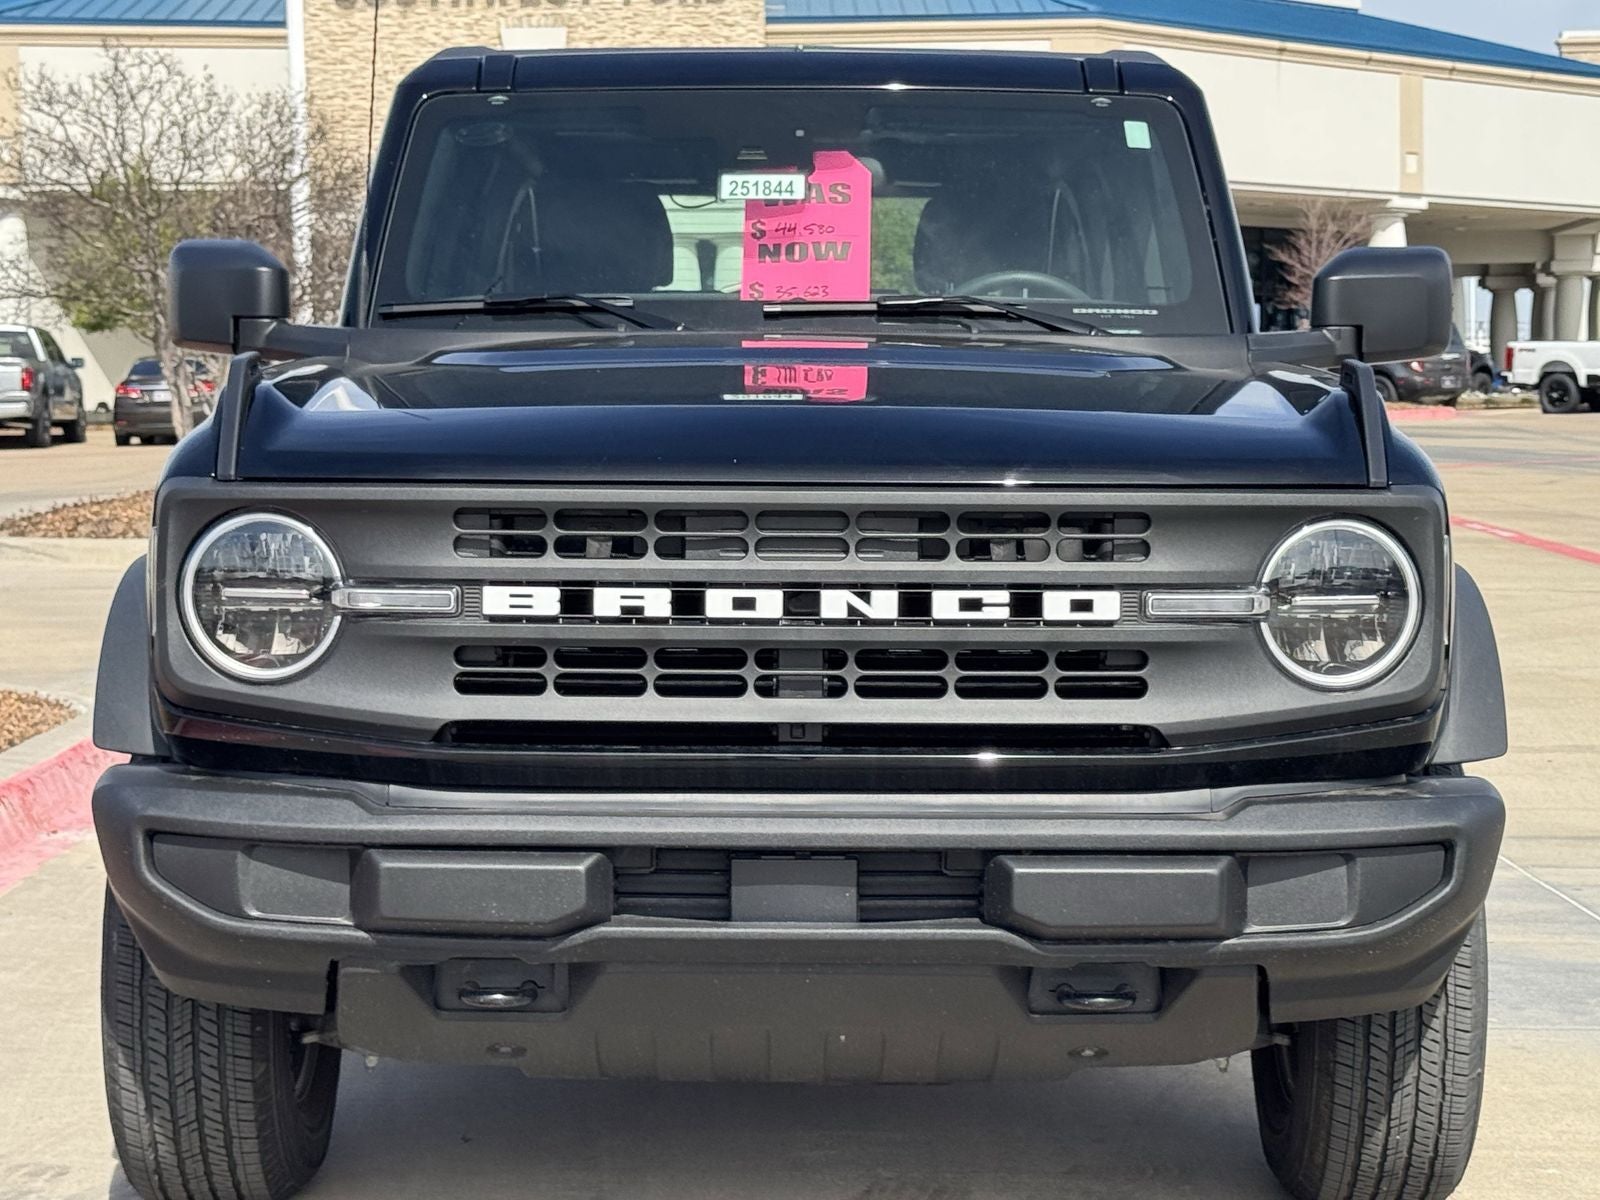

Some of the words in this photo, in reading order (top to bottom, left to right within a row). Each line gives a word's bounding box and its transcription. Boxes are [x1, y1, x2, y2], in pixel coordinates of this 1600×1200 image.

[729, 180, 795, 196] 251844
[764, 183, 852, 207] AS
[751, 219, 767, 241] $
[758, 242, 852, 263] NOW
[749, 281, 764, 301] $
[481, 585, 1122, 622] BRONCO
